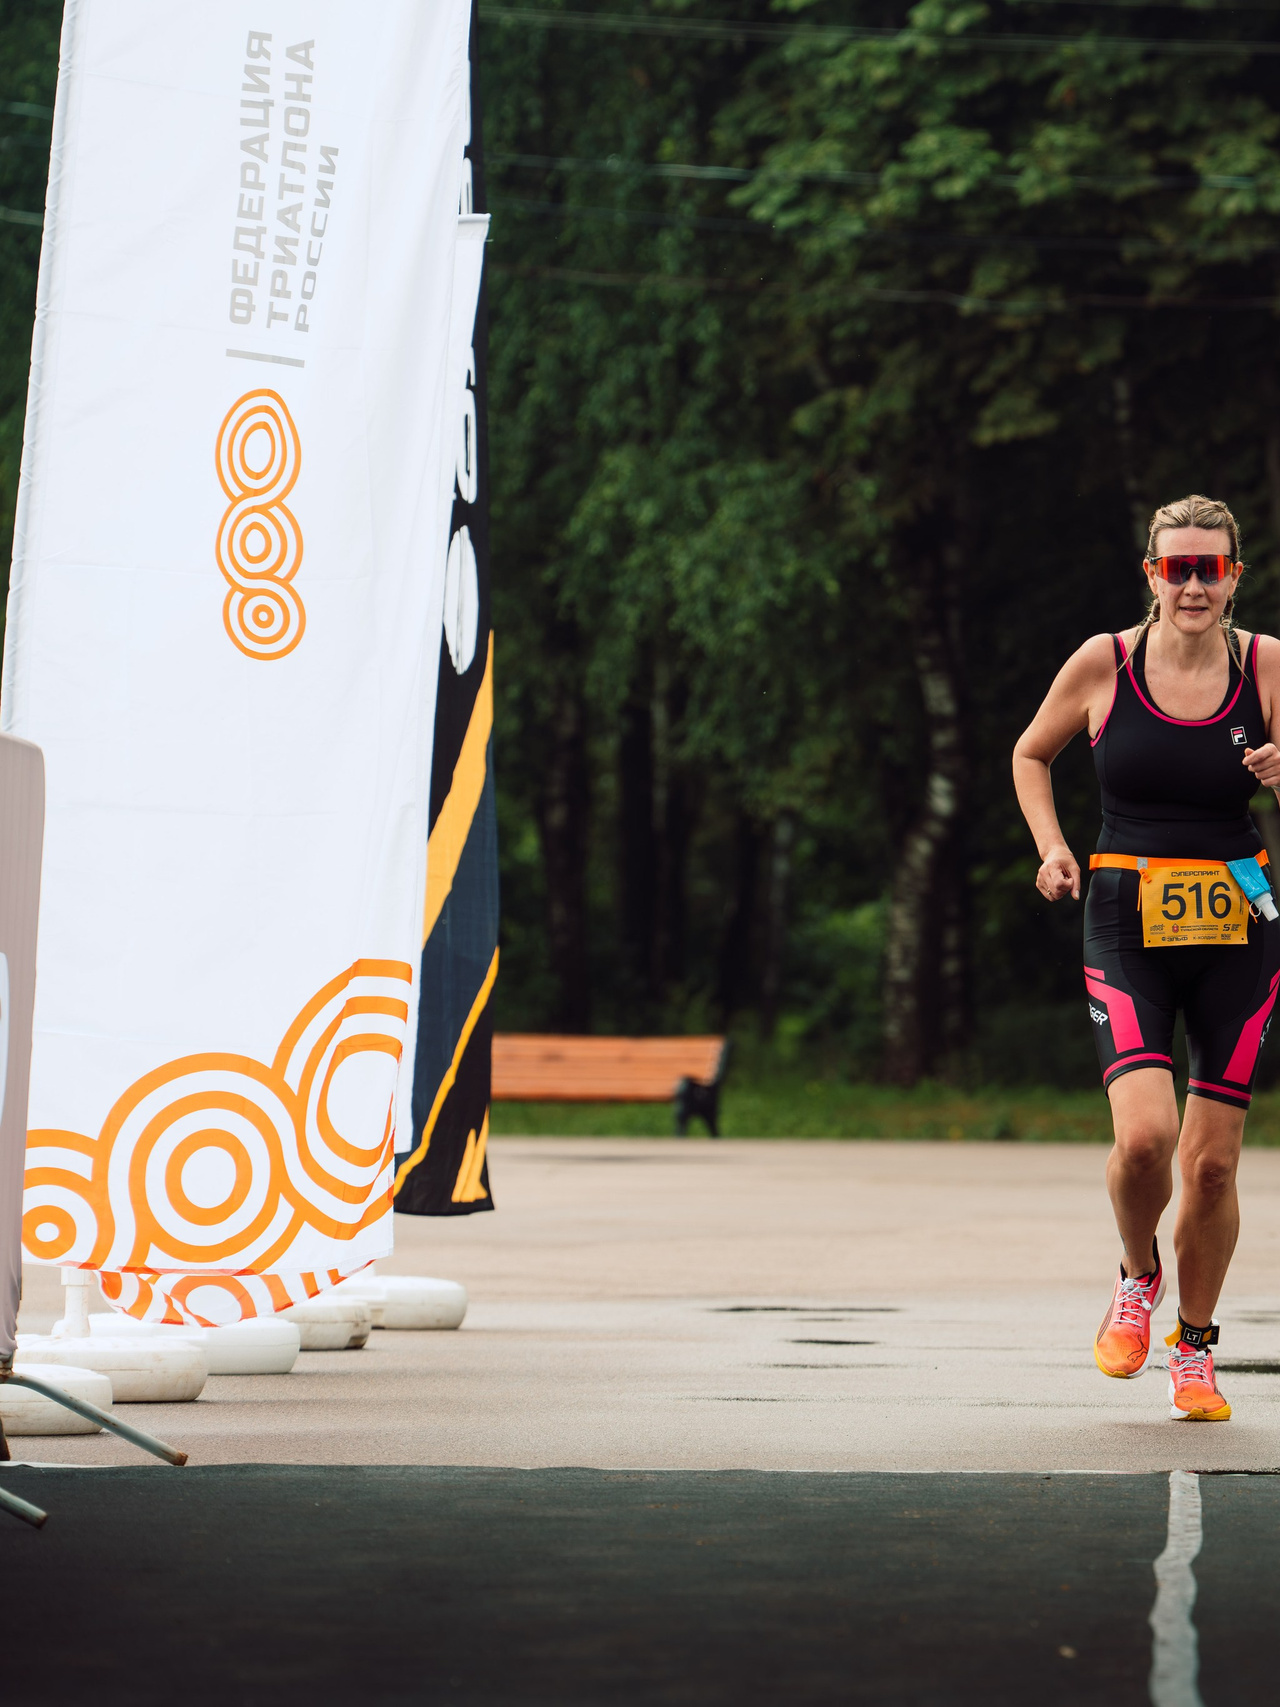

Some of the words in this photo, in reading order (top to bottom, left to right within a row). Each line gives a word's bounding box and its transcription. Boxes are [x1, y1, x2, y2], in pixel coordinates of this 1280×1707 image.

[229, 30, 275, 325] ФЕДЕРАЦИЯ
[266, 38, 315, 329] ТРИАТЛОНА
[294, 144, 339, 333] РОССИИ
[1162, 882, 1232, 920] 516
[1186, 1332, 1198, 1341] LT
